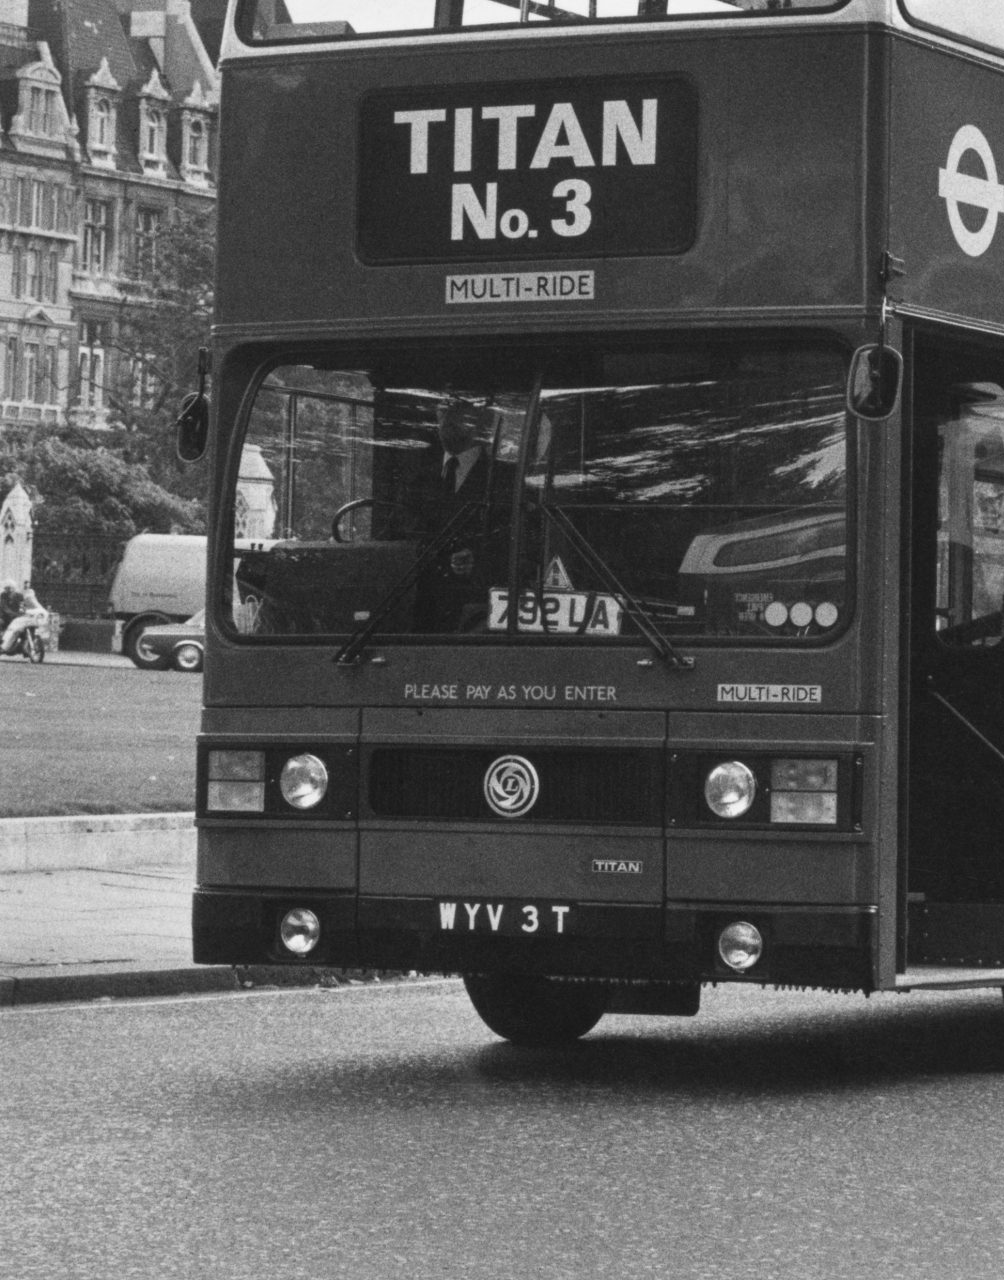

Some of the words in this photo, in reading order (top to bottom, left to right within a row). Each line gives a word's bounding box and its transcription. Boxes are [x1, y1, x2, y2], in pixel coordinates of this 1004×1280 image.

[394, 99, 657, 174] TITAN
[451, 183, 537, 240] No.
[551, 179, 591, 236] 3
[450, 275, 590, 300] MULTI-RIDE
[404, 684, 458, 700] PLEASE
[466, 684, 491, 700] PAY
[497, 685, 516, 700] AS
[522, 685, 556, 701] YOU
[564, 685, 617, 701] ENTER
[719, 686, 819, 703] MULTI-RIDE
[594, 860, 640, 873] TITAN
[439, 902, 504, 931] WYV
